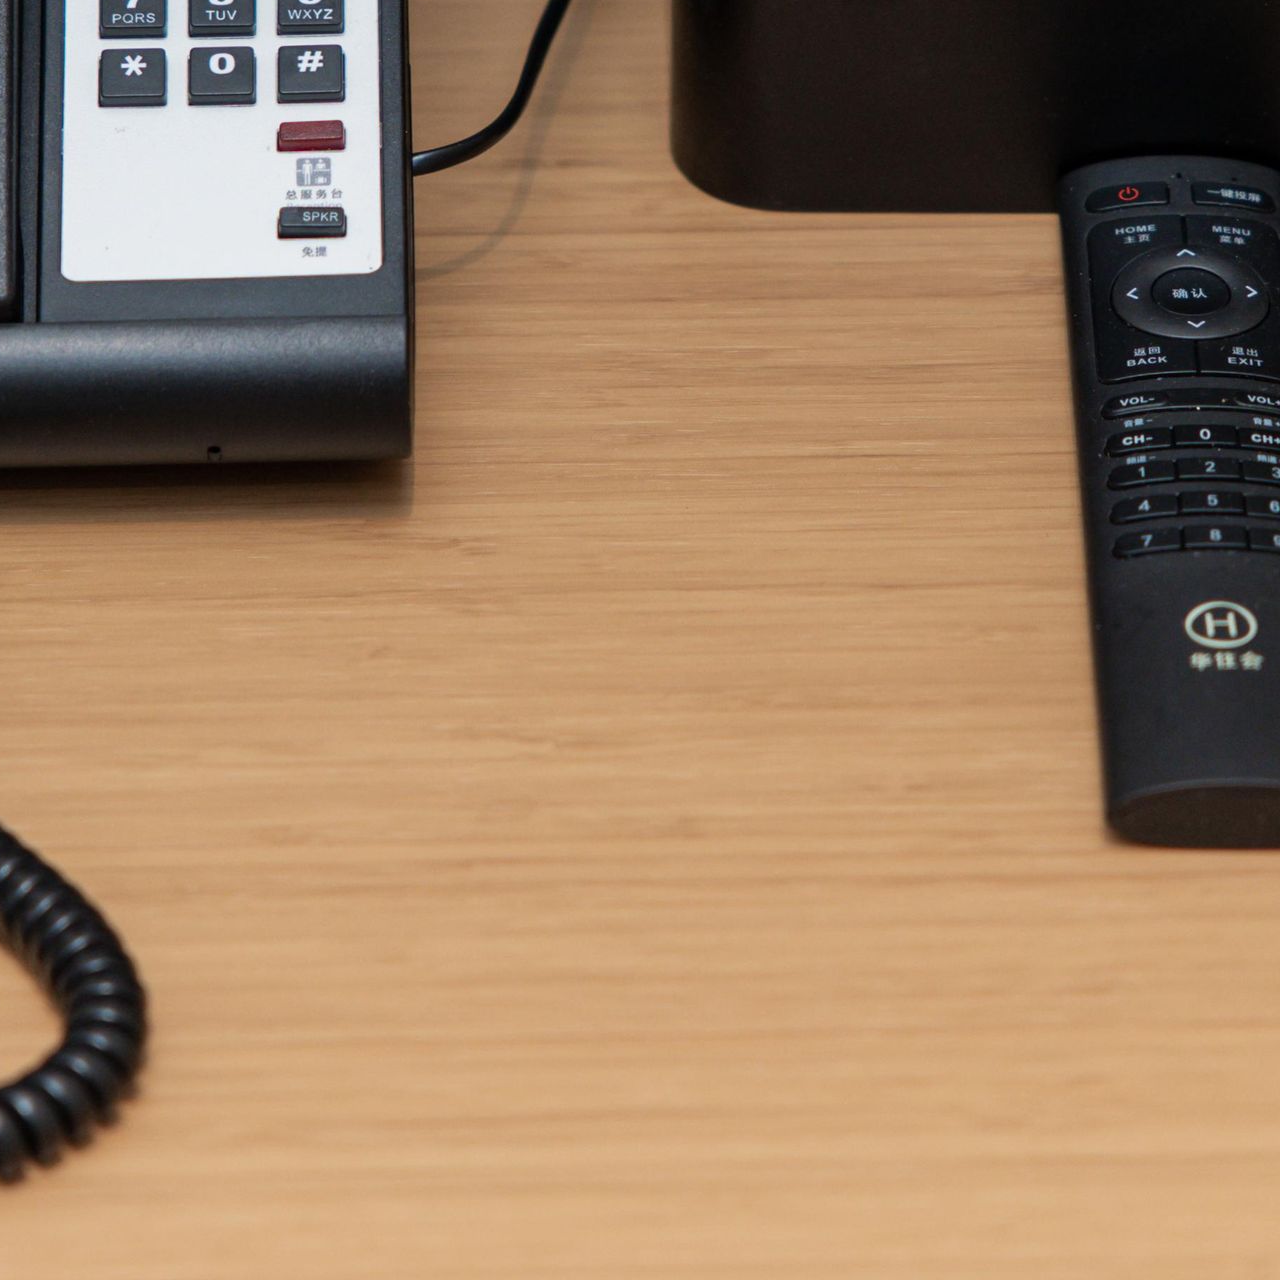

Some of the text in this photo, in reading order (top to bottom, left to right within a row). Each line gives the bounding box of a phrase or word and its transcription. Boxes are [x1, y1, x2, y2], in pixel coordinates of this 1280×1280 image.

[112, 12, 156, 24] PQRS
[205, 9, 237, 21] TUV
[287, 8, 334, 20] WXYZ
[209, 52, 236, 75] 0
[285, 188, 343, 201] 总服务台
[302, 211, 338, 222] SPKR
[1115, 224, 1157, 236] HOME
[1212, 225, 1251, 237] MENU
[1125, 234, 1150, 244] 主页
[1220, 235, 1246, 245] 菜单
[302, 246, 327, 258] 免提
[1172, 287, 1208, 299] 确认
[1133, 346, 1162, 357] 返回
[1231, 346, 1259, 357] 退出
[1127, 355, 1168, 367] BACK
[1227, 357, 1263, 367] EXIT
[1119, 396, 1155, 407] VOL-
[1122, 434, 1154, 446] CH-
[1199, 428, 1211, 440] 0
[1138, 466, 1146, 478] 1
[1205, 461, 1216, 473] 2
[1138, 499, 1150, 511] 4
[1207, 494, 1218, 506] 5
[1269, 500, 1280, 513] 6
[1141, 534, 1153, 547] 7
[1210, 529, 1222, 541] 8
